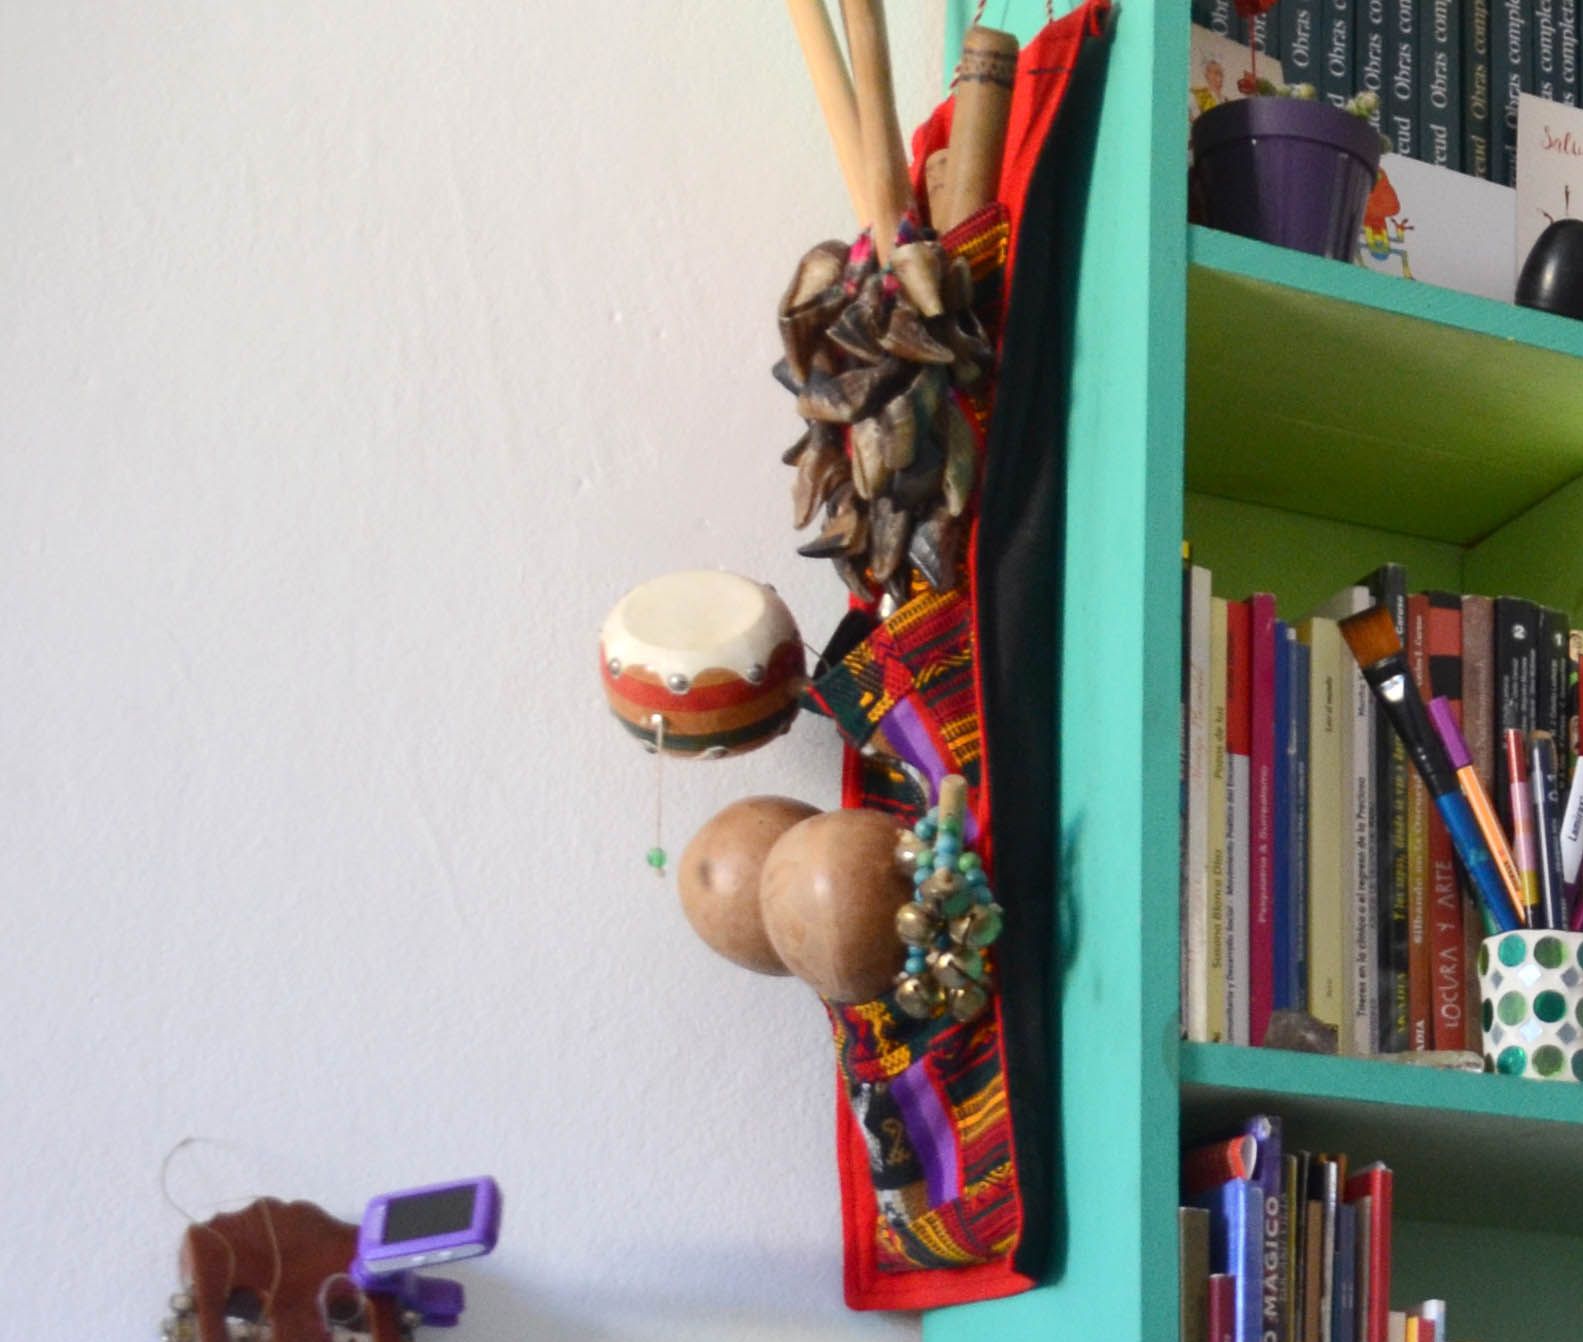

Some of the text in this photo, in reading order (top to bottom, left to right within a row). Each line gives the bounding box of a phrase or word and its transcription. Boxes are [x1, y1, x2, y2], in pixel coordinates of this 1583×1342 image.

[1291, 9, 1311, 68] Obras
[1327, 19, 1346, 78] Obras
[1363, 33, 1383, 91] Obras
[1393, 43, 1412, 101] Obras
[1430, 51, 1448, 109] Obras
[1471, 63, 1489, 120] Obras
[1512, 624, 1526, 639] 2
[1554, 632, 1564, 647] 1
[1357, 964, 1368, 978] en
[1434, 859, 1462, 1029] LOCURA Y ARTE
